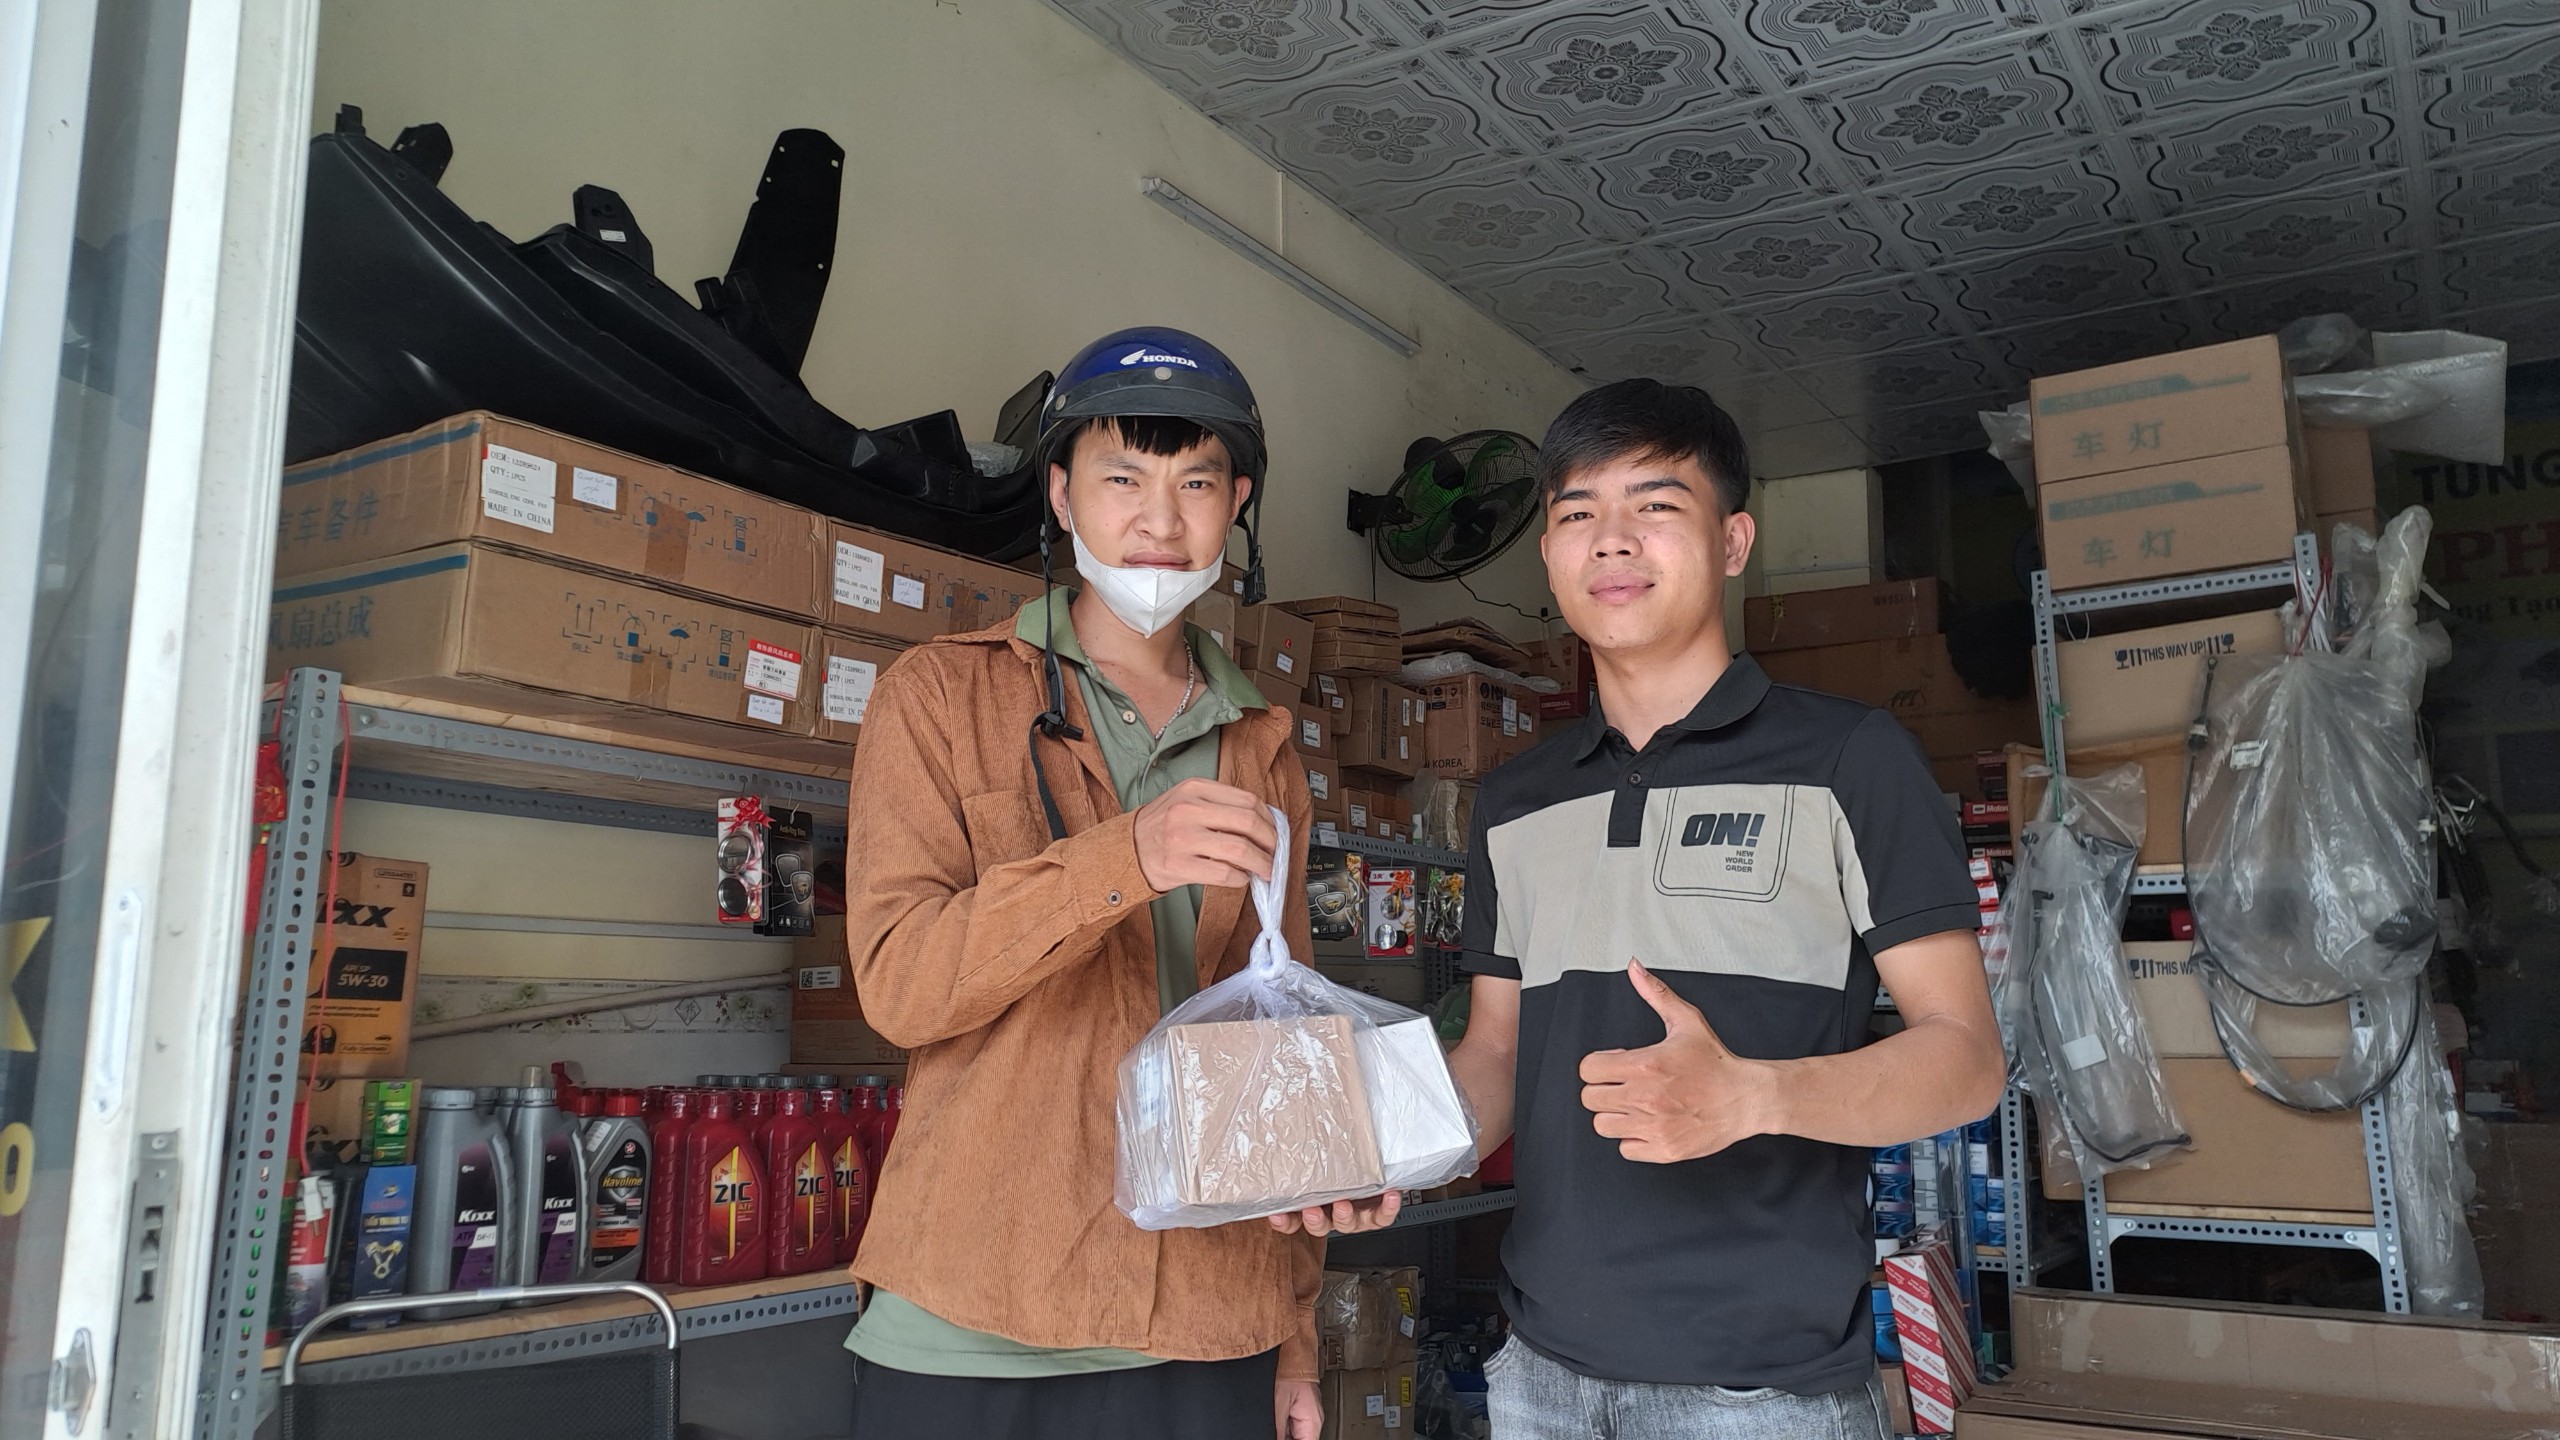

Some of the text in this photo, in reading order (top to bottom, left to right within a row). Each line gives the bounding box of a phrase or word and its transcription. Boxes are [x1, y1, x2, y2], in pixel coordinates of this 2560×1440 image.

[1142, 354, 1198, 369] HONDA
[487, 501, 552, 526] MADE IN CHINA
[853, 593, 860, 601] IN
[2142, 639, 2207, 662] THIS WAY UP!
[1432, 758, 1463, 769] KOREA
[1681, 813, 1765, 847] ON!
[1725, 857, 1754, 865] WORLD
[1725, 865, 1753, 873] ORDER
[2155, 961, 2179, 976] THIS
[337, 973, 389, 989] 5W-30
[602, 1175, 644, 1189] Havoline
[797, 1176, 826, 1196] ZIC
[835, 1169, 860, 1188] ZIC
[714, 1182, 752, 1204] ZIC
[738, 1203, 753, 1211] ATF
[456, 1231, 475, 1241] ATF
